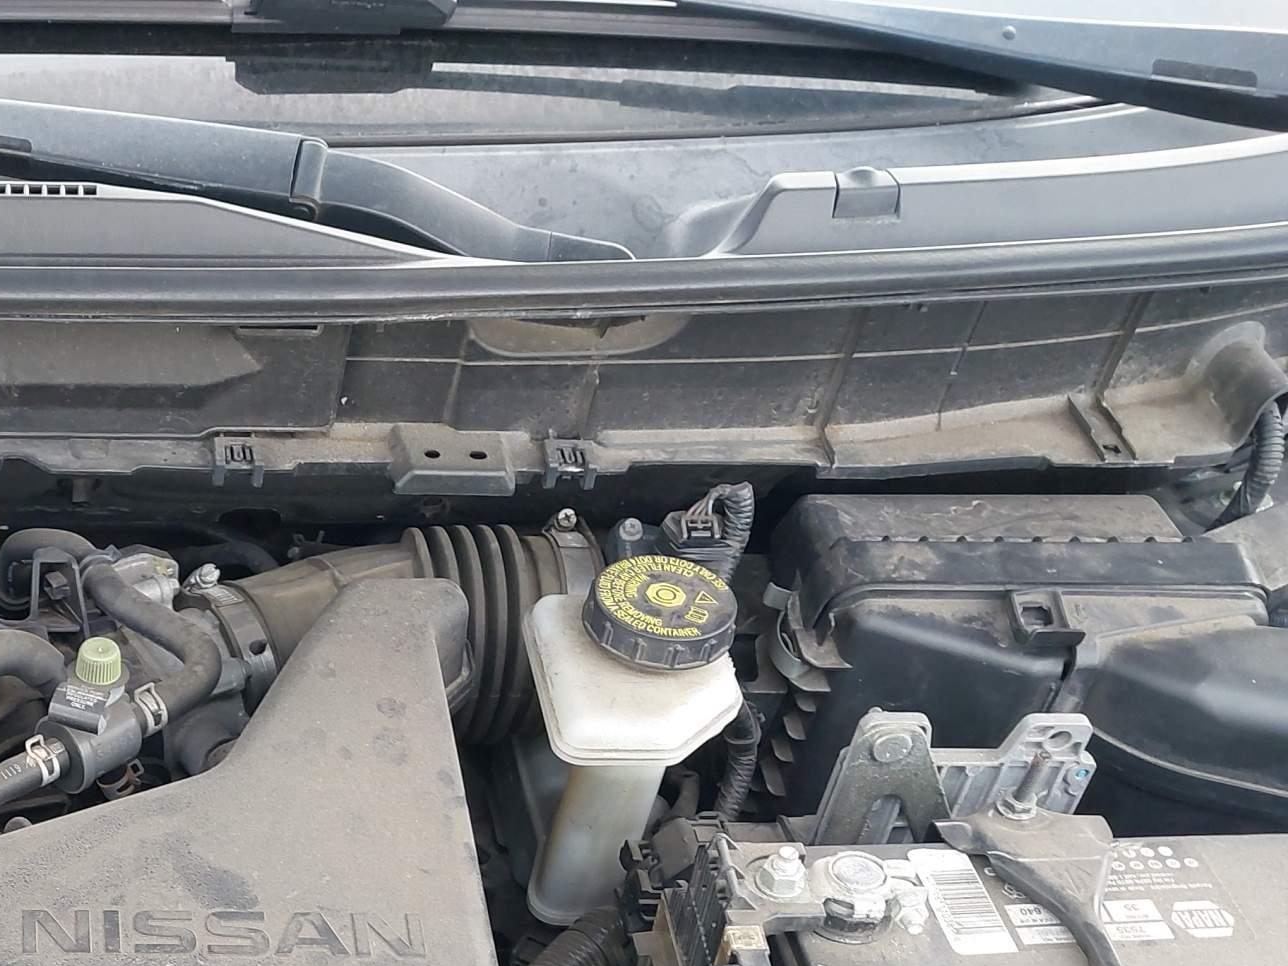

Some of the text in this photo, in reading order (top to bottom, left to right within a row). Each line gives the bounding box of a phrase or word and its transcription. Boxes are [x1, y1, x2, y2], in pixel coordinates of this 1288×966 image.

[632, 555, 653, 565] DOT4
[654, 556, 668, 564] OR
[670, 558, 694, 570] DOT3
[636, 563, 662, 573] FILLER
[663, 563, 694, 577] CLEAN
[619, 601, 663, 626] REMOVING
[646, 625, 701, 638] CONTAINER
[1177, 909, 1227, 929] NAPA
[21, 907, 427, 959] NISSAN
